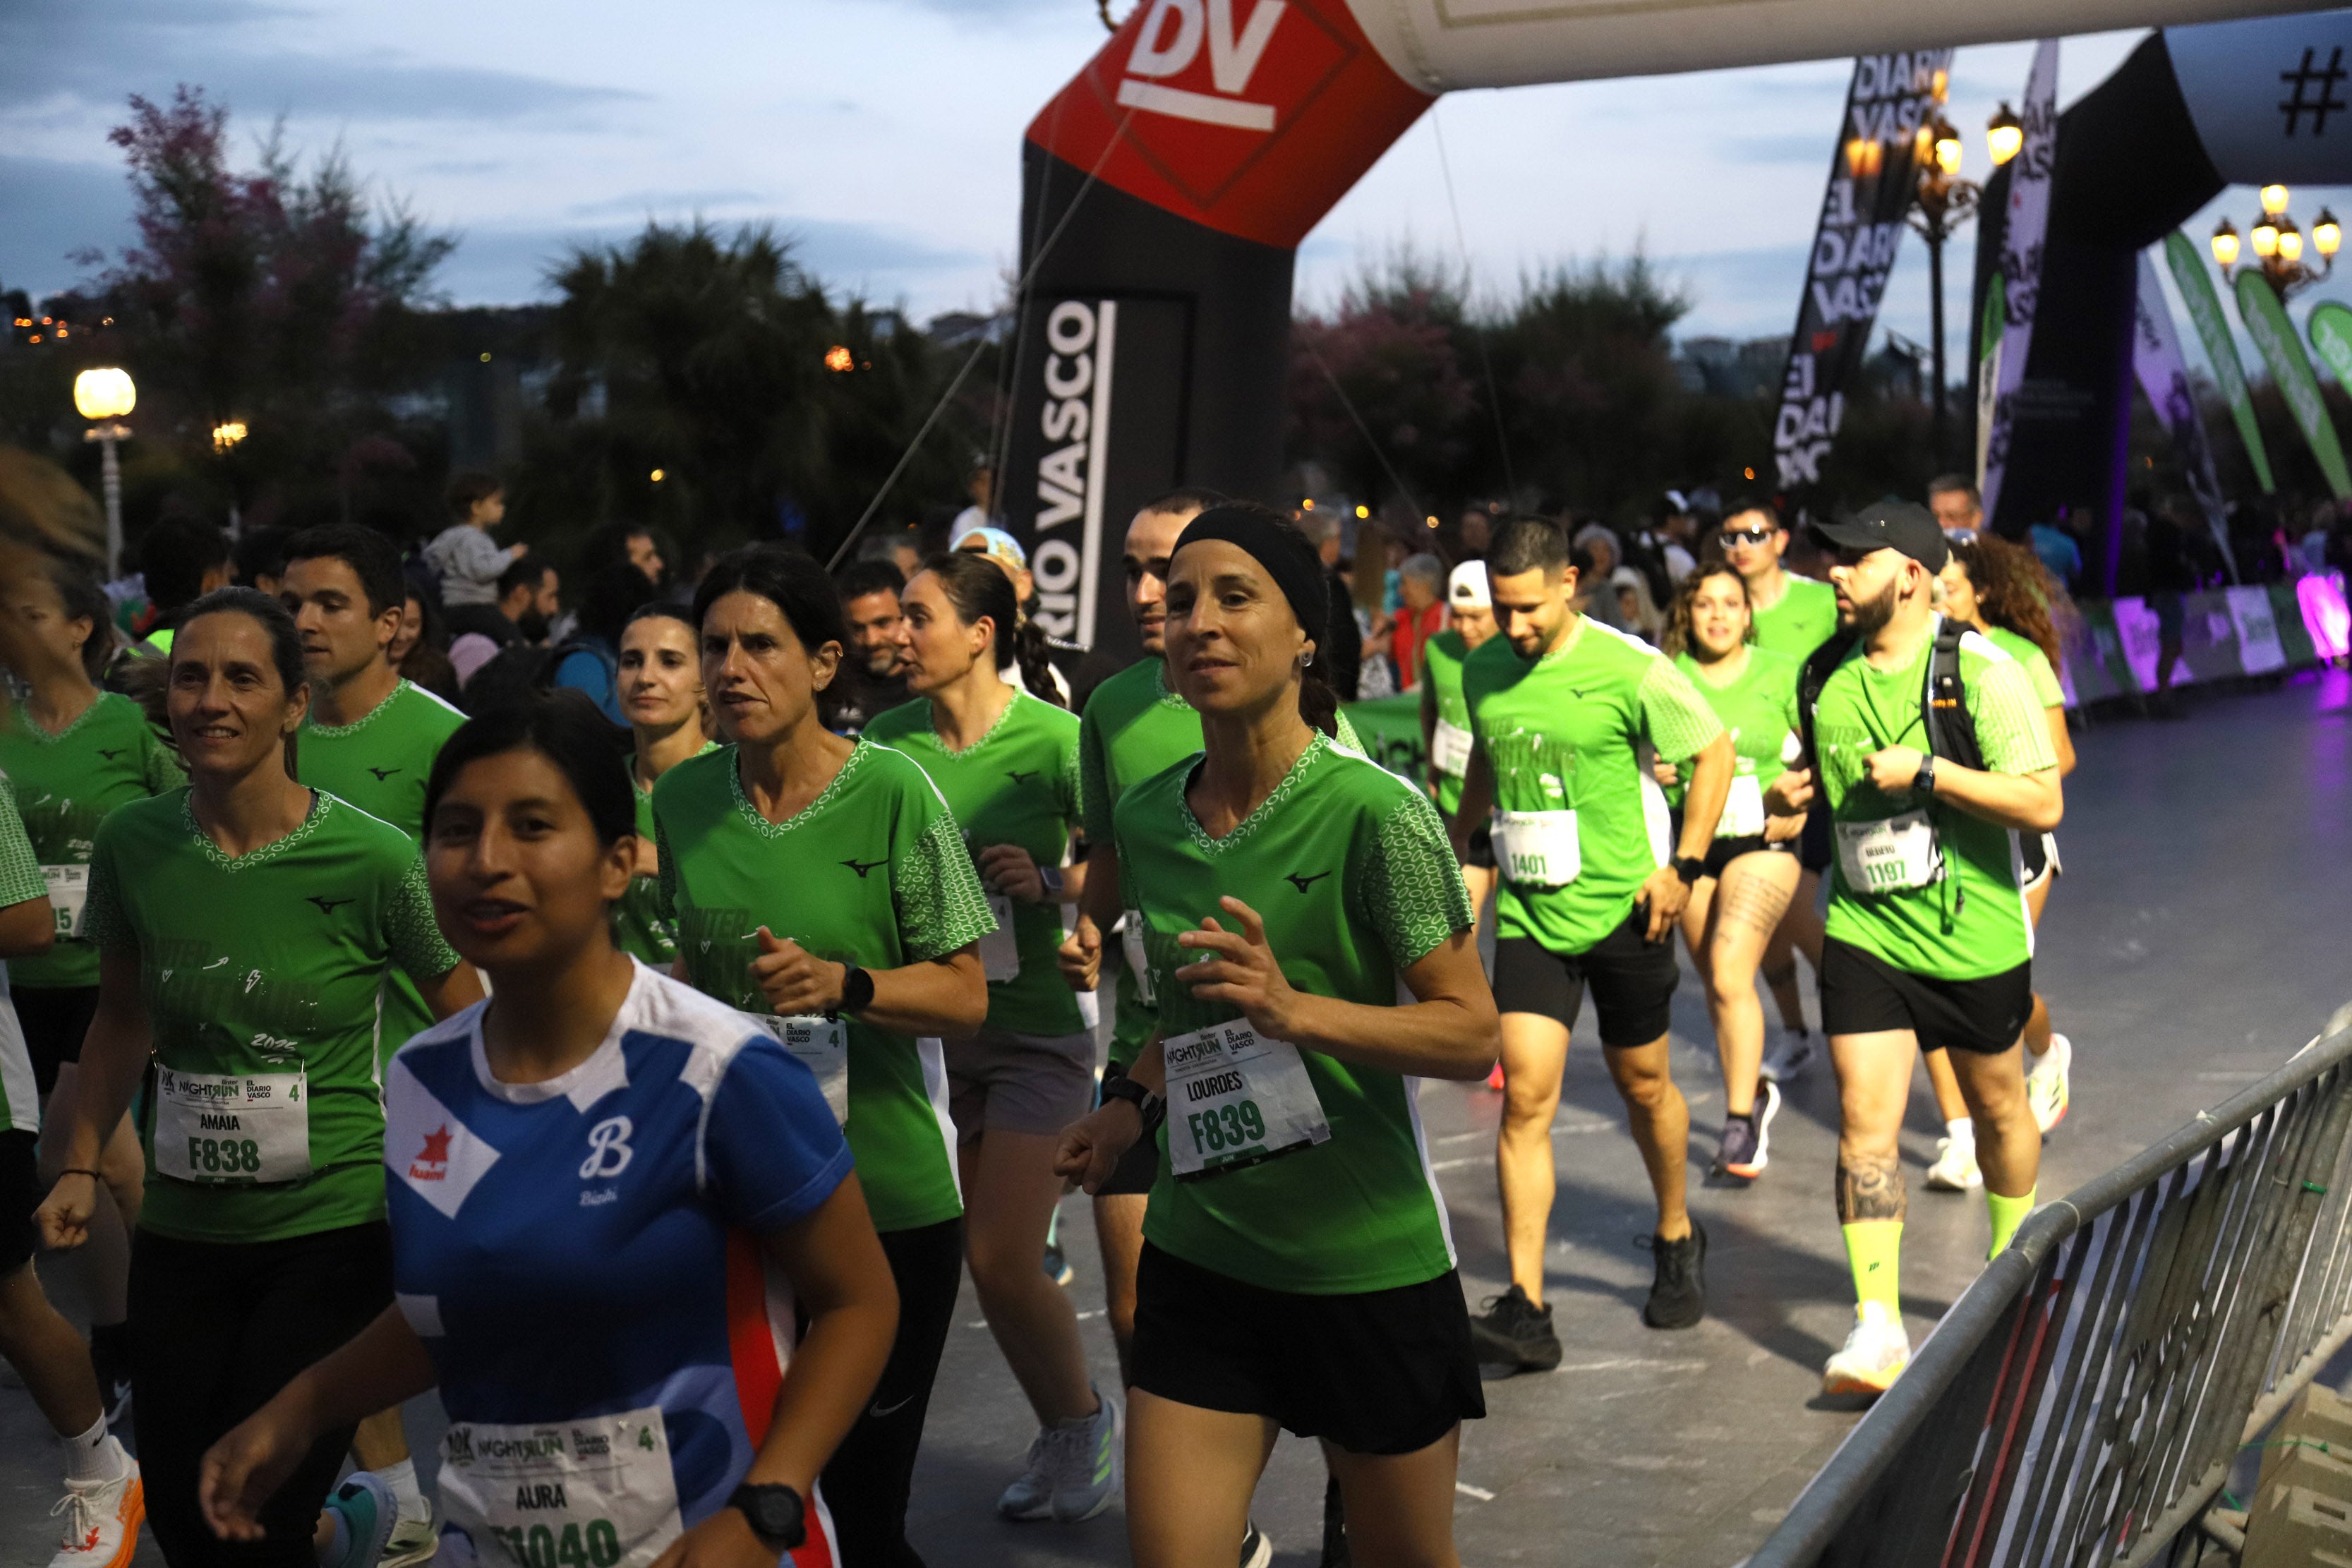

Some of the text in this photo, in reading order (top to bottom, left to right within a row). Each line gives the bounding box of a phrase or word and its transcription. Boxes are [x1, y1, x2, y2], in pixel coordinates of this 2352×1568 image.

[1125, 0, 1289, 95] DV
[1035, 300, 1097, 533] VASCO
[1512, 853, 1547, 875] 1401
[1866, 860, 1906, 884] 1197
[250, 1032, 298, 1051] 2025
[828, 1030, 840, 1048] 4
[1224, 1029, 1234, 1037] EL
[1226, 1031, 1253, 1044] DIARIO
[1229, 1039, 1255, 1051] VASCO
[289, 1084, 300, 1102] 4
[1186, 1071, 1243, 1102] LOURDES
[200, 1114, 241, 1130] AMAIA
[1188, 1099, 1266, 1154] F839
[188, 1136, 260, 1173] F838
[1222, 1154, 1234, 1163] JUN
[638, 1425, 654, 1452] 4
[516, 1483, 567, 1511] AURA
